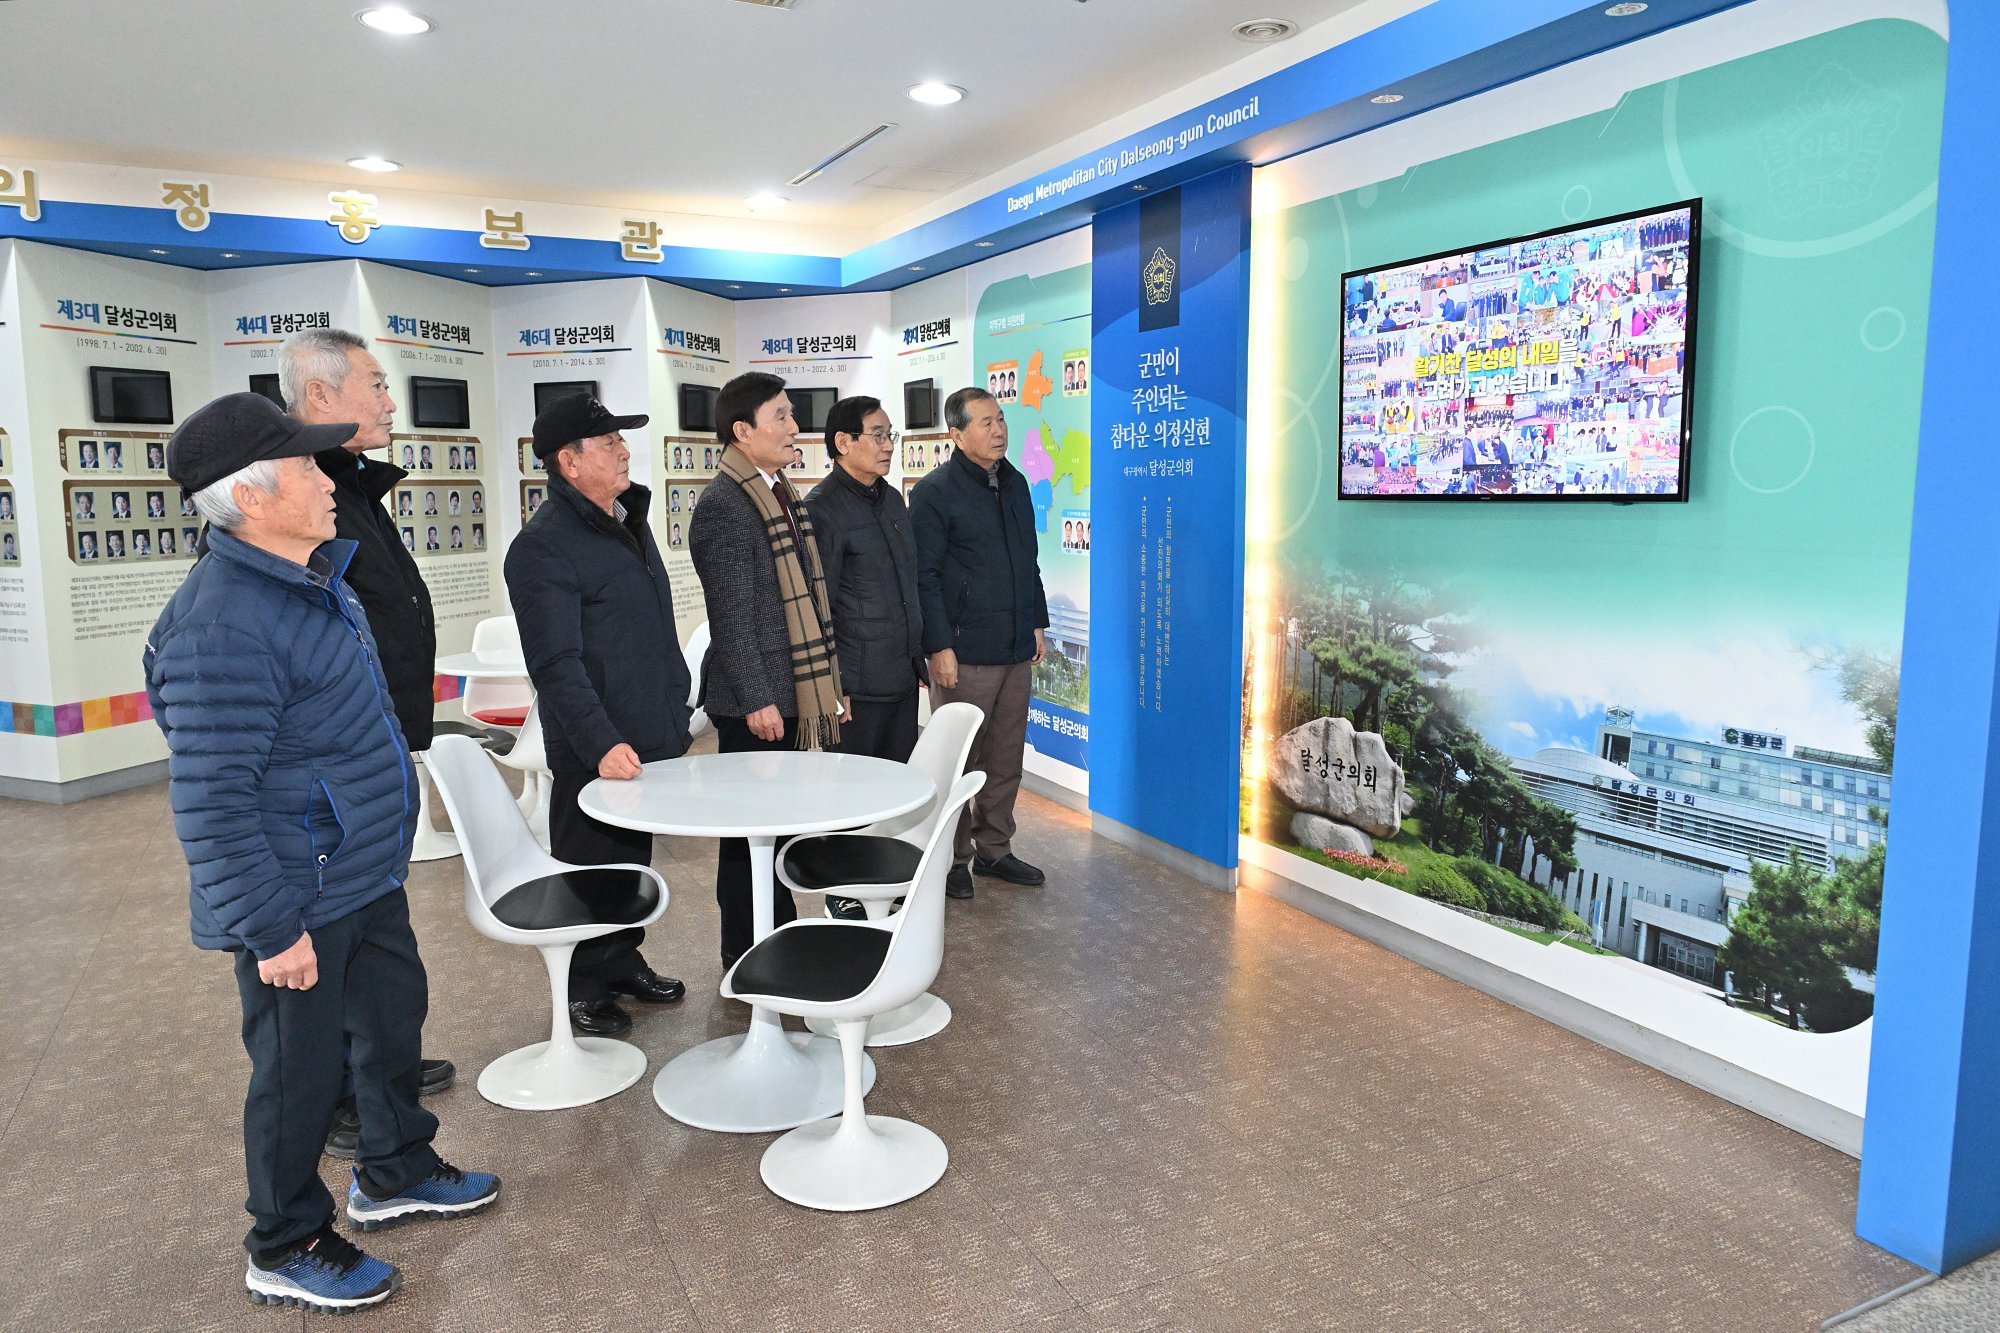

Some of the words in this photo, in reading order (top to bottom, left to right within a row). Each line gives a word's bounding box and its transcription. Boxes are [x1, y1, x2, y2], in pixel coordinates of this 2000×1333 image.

[1007, 193, 1035, 213] Daegu
[1035, 166, 1095, 202] Metropolitan
[1097, 157, 1118, 177] City
[1120, 123, 1203, 168] Dalseong-gun
[1207, 96, 1260, 134] Council
[162, 182, 209, 227] 정
[330, 194, 377, 240] 홍
[484, 209, 526, 247] 보
[622, 221, 663, 259] 관
[57, 299, 100, 324] 제3대
[105, 305, 177, 333] 달성군의회
[236, 315, 268, 335] 제4대
[270, 311, 330, 334] 달성군의회
[387, 315, 417, 337] 제5대
[420, 319, 470, 344] 달성군의회
[919, 317, 951, 342] 달성군의회
[519, 328, 551, 346] 제6대
[554, 325, 615, 345] 달성군의회
[664, 327, 684, 348] 제7대
[686, 331, 720, 354] 달성군의회
[762, 337, 793, 355] 제8대
[796, 334, 857, 354] 달성군의회
[1138, 346, 1180, 379] 군민이
[1414, 352, 1462, 378] 활기찬
[1466, 345, 1517, 373] 달성의
[1522, 337, 1578, 366] 내일을
[1131, 384, 1188, 415] 주인되는
[1423, 377, 1487, 401] 그려가고
[1110, 422, 1150, 450] 참다운
[1153, 417, 1211, 448] 의정실현
[1149, 458, 1194, 477] 달성군의회
[1052, 715, 1089, 742] 달성군의회
[1301, 747, 1377, 793] 달성군의회
[1611, 779, 1696, 806] 달성군의회
